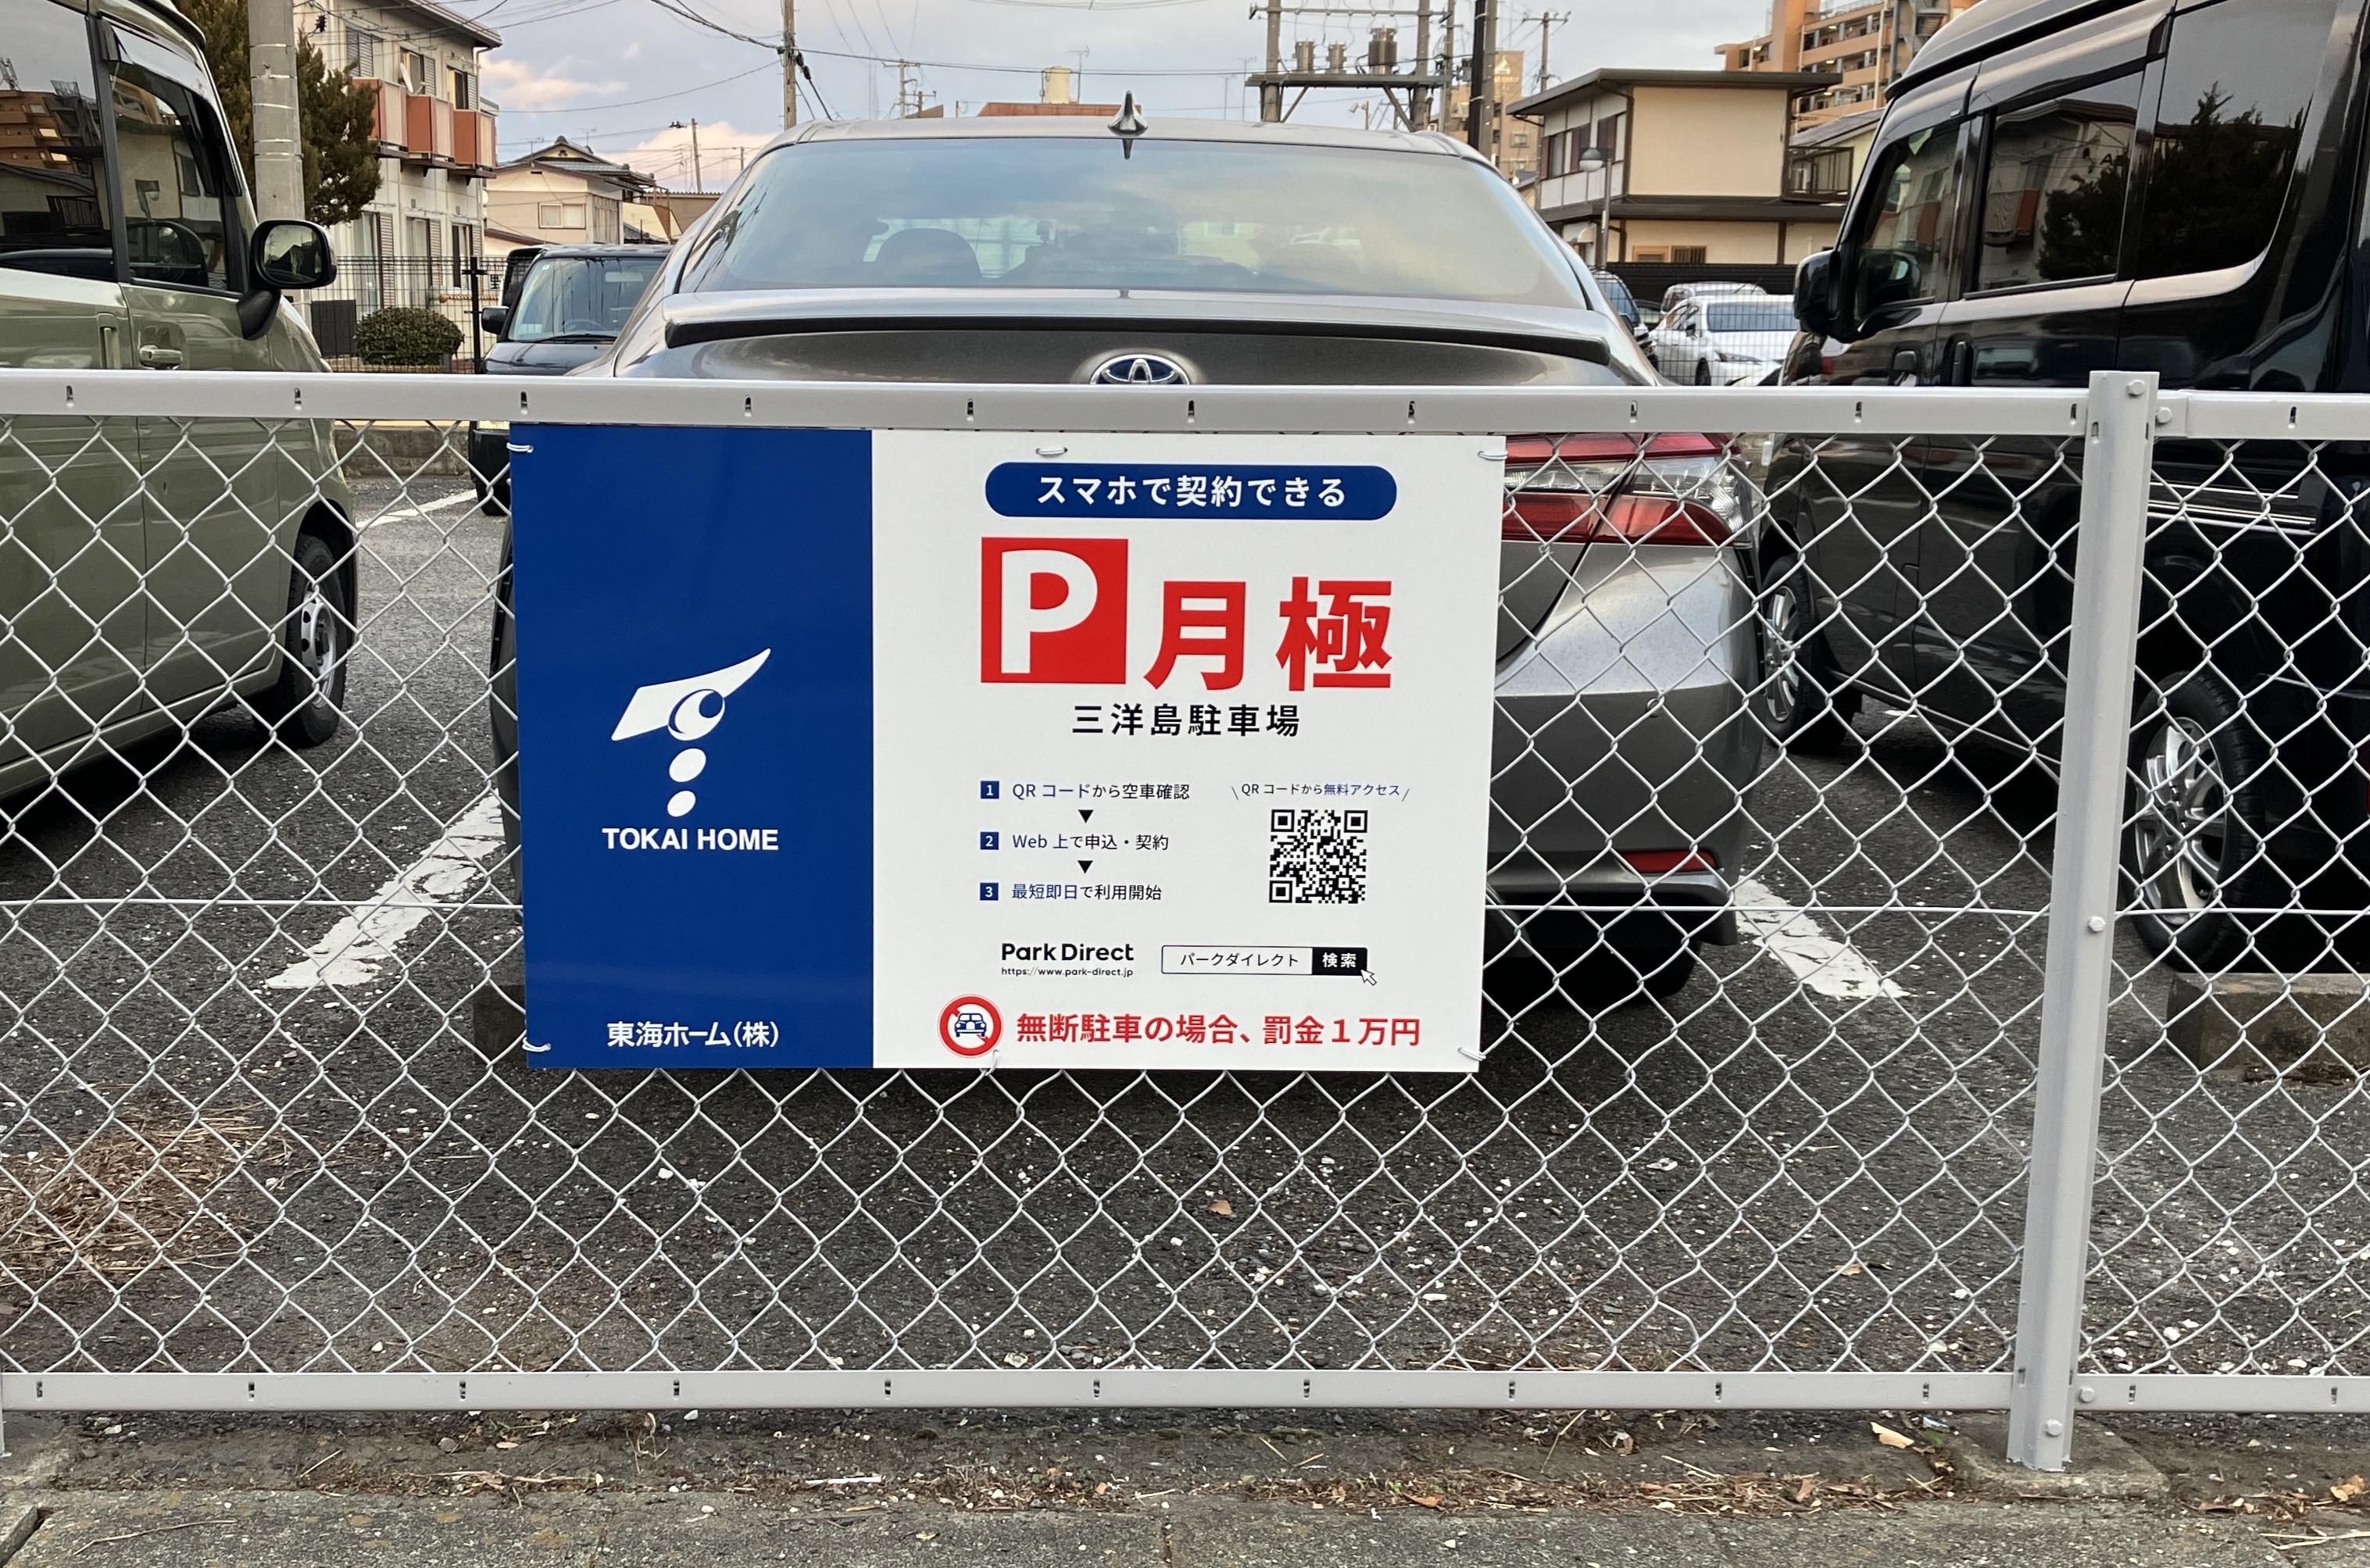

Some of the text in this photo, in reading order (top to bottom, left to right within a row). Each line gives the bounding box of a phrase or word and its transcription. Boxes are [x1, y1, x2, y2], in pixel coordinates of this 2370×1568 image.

[1037, 474, 1346, 508] スマホで契約できる
[1001, 548, 1392, 692] P 月極
[1071, 702, 1300, 738] 三洋島駐車場
[602, 827, 780, 851] TOKAI HOME
[1011, 883, 1162, 901] 最短即日で利用開始
[1001, 942, 1135, 962] Park Direct
[1180, 952, 1357, 969] パークダイレクト 検索
[1001, 967, 1134, 978] https://www.park-direct.jp
[607, 1020, 780, 1048] 東海ホーム(株)
